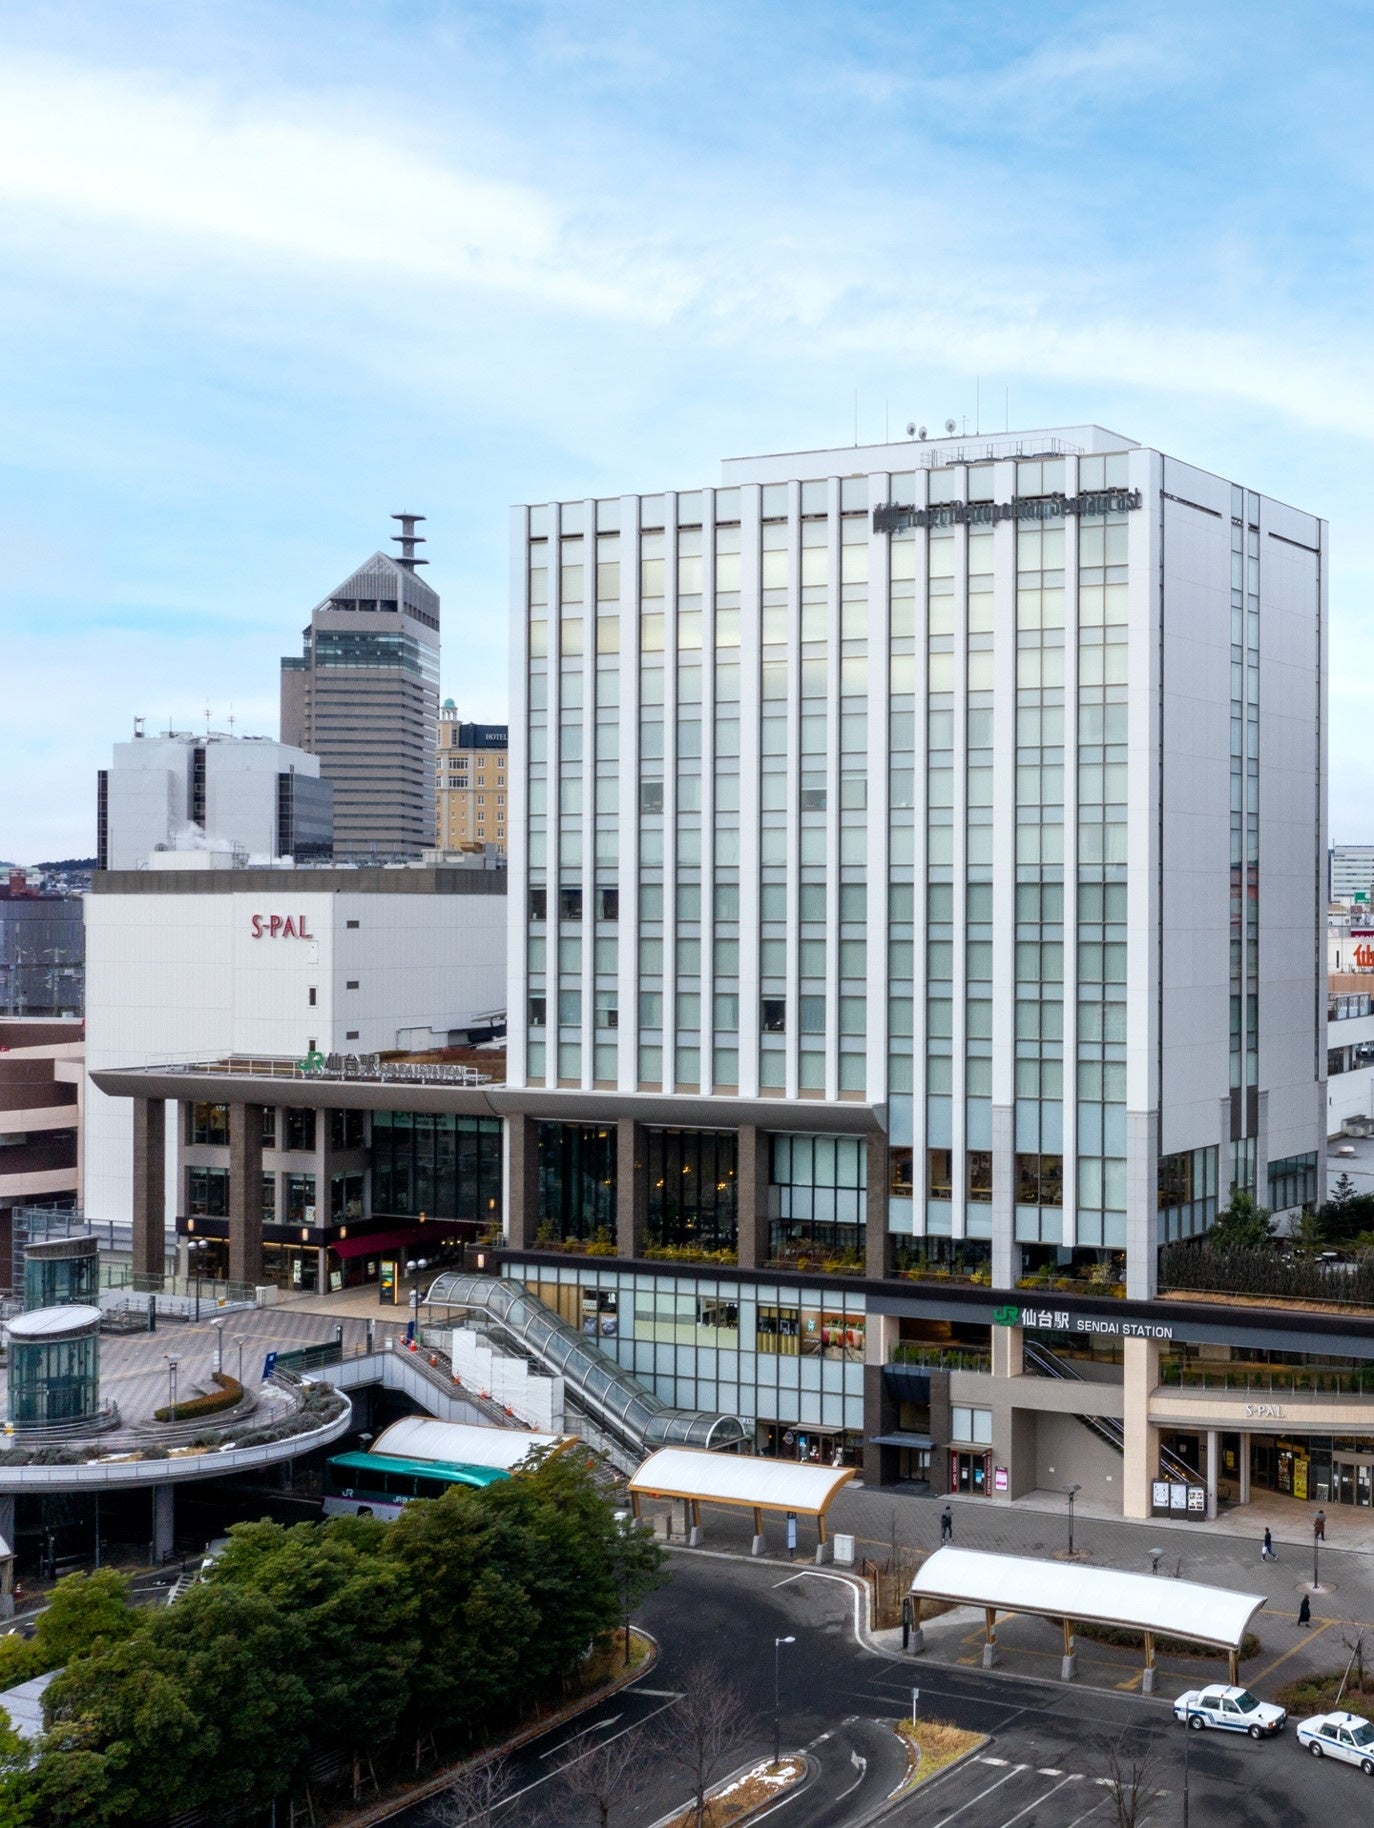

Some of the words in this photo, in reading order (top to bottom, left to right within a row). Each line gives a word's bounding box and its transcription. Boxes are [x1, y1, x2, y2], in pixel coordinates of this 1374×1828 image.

[251, 914, 313, 939] S-PAL
[325, 1053, 380, 1073] 仙台駅
[1022, 1308, 1070, 1330] 仙台駅
[1076, 1320, 1119, 1335] SENDAI
[1122, 1324, 1173, 1339] STATION
[1246, 1404, 1285, 1418] S-PAL
